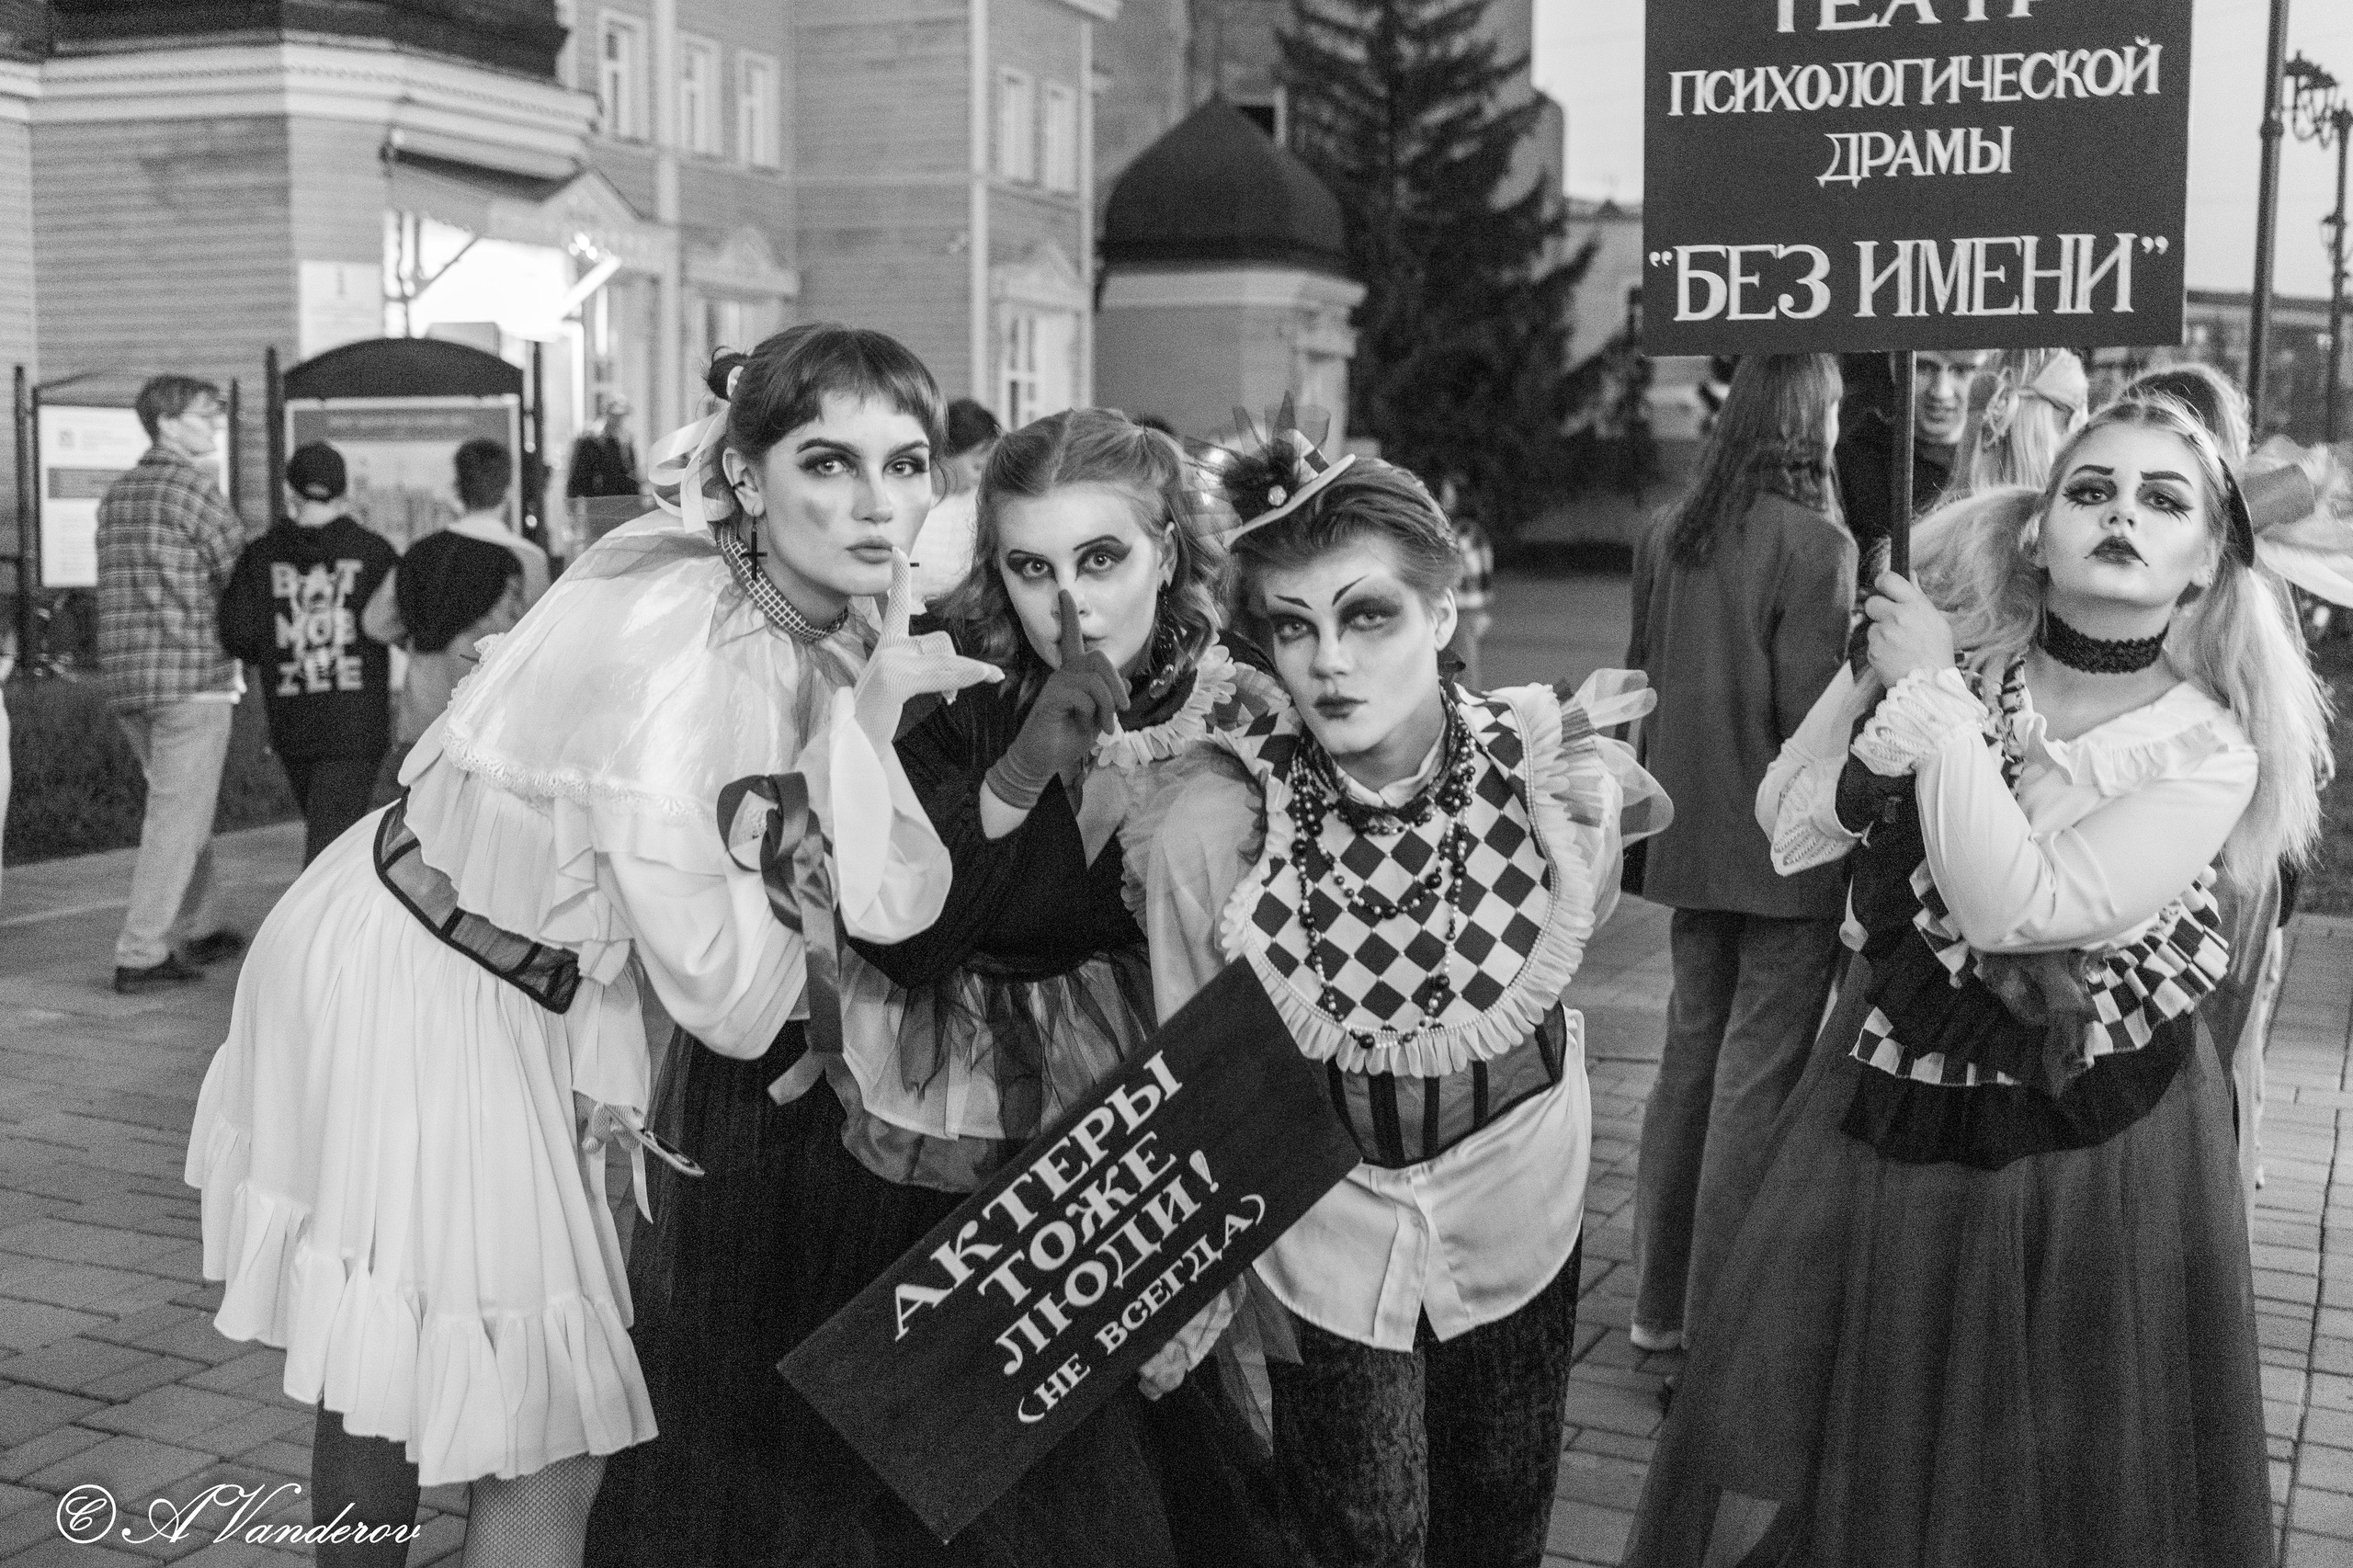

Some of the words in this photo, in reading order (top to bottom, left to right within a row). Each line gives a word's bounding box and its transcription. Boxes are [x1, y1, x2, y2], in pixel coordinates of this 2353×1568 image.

[1668, 36, 2164, 116] ПСИХОЛОГИЧЕСКОЙ
[1816, 125, 2014, 187] ДРАМЫ
[894, 1049, 1184, 1342] АКТЕРЫ
[977, 1131, 1176, 1306] ТОЖЕ
[1017, 1352, 1092, 1424] (НЕ
[1094, 1194, 1267, 1355] ВСЕГДА)
